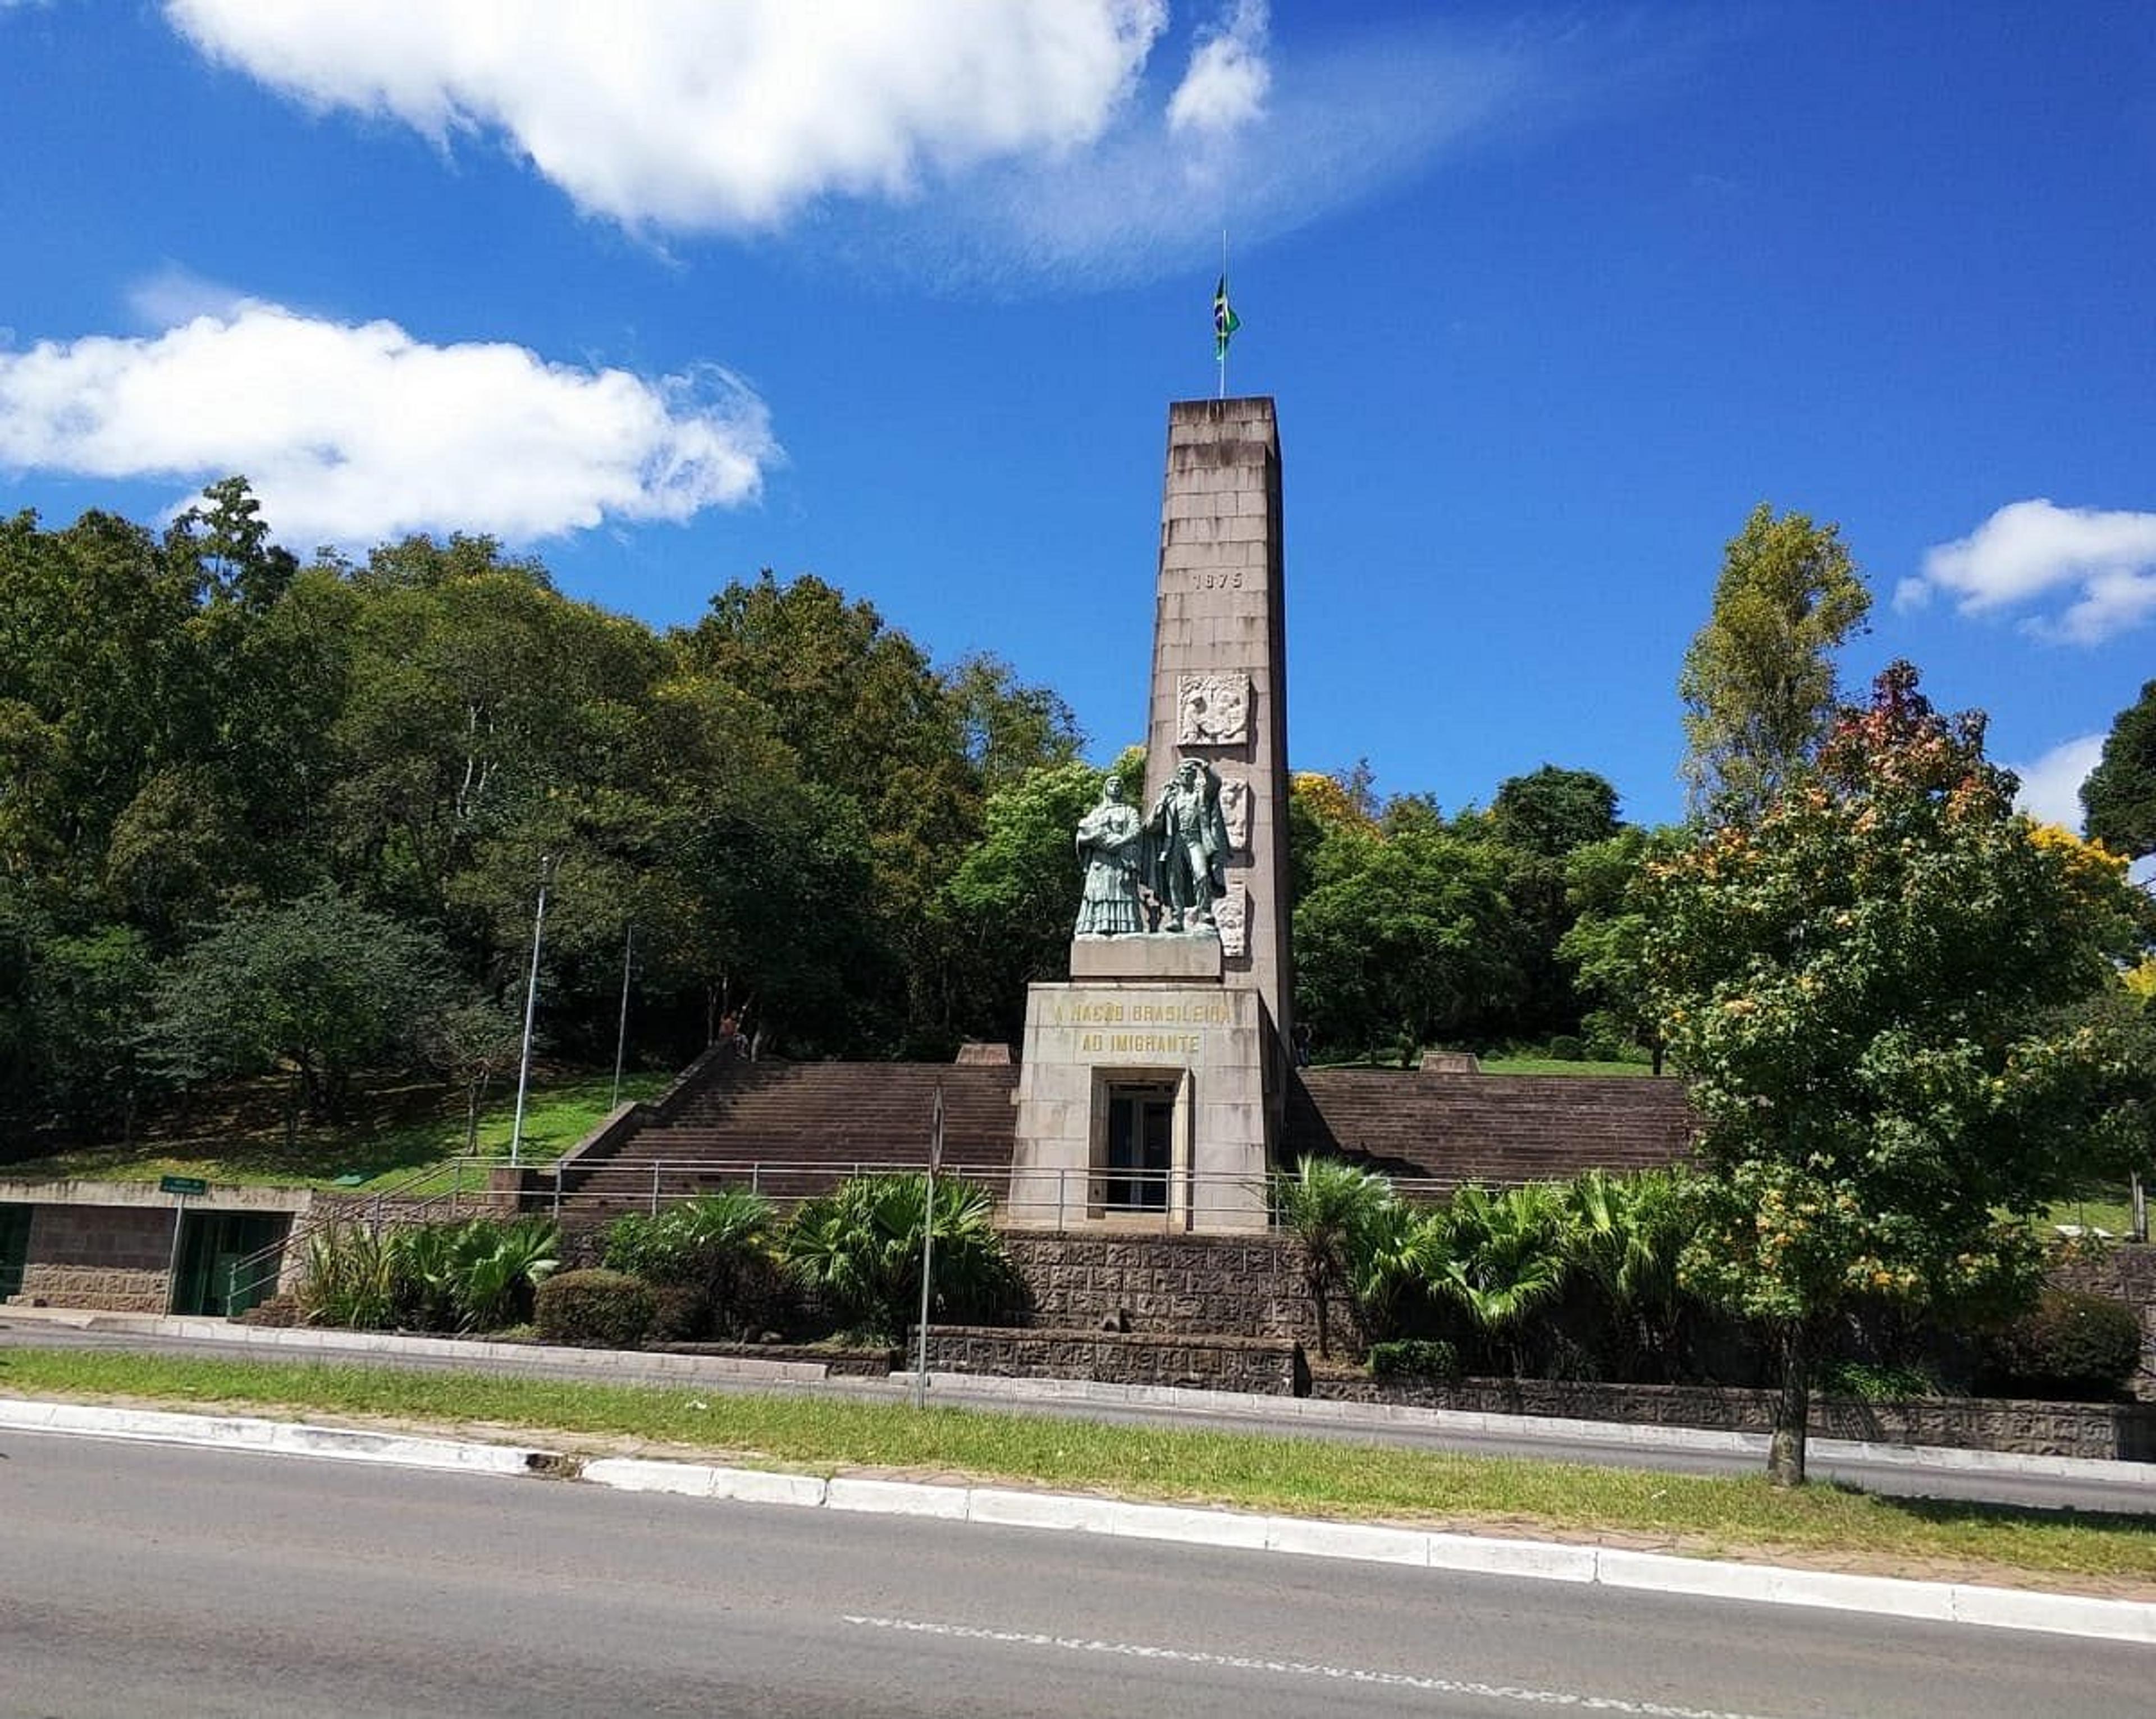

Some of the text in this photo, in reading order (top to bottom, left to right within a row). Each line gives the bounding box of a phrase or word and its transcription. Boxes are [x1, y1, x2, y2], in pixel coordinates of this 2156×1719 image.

[1193, 573, 1243, 590] 1875
[1132, 1005, 1230, 1023] BRASILEIRA
[1082, 1034, 1200, 1052] AO IMIGRANTE
